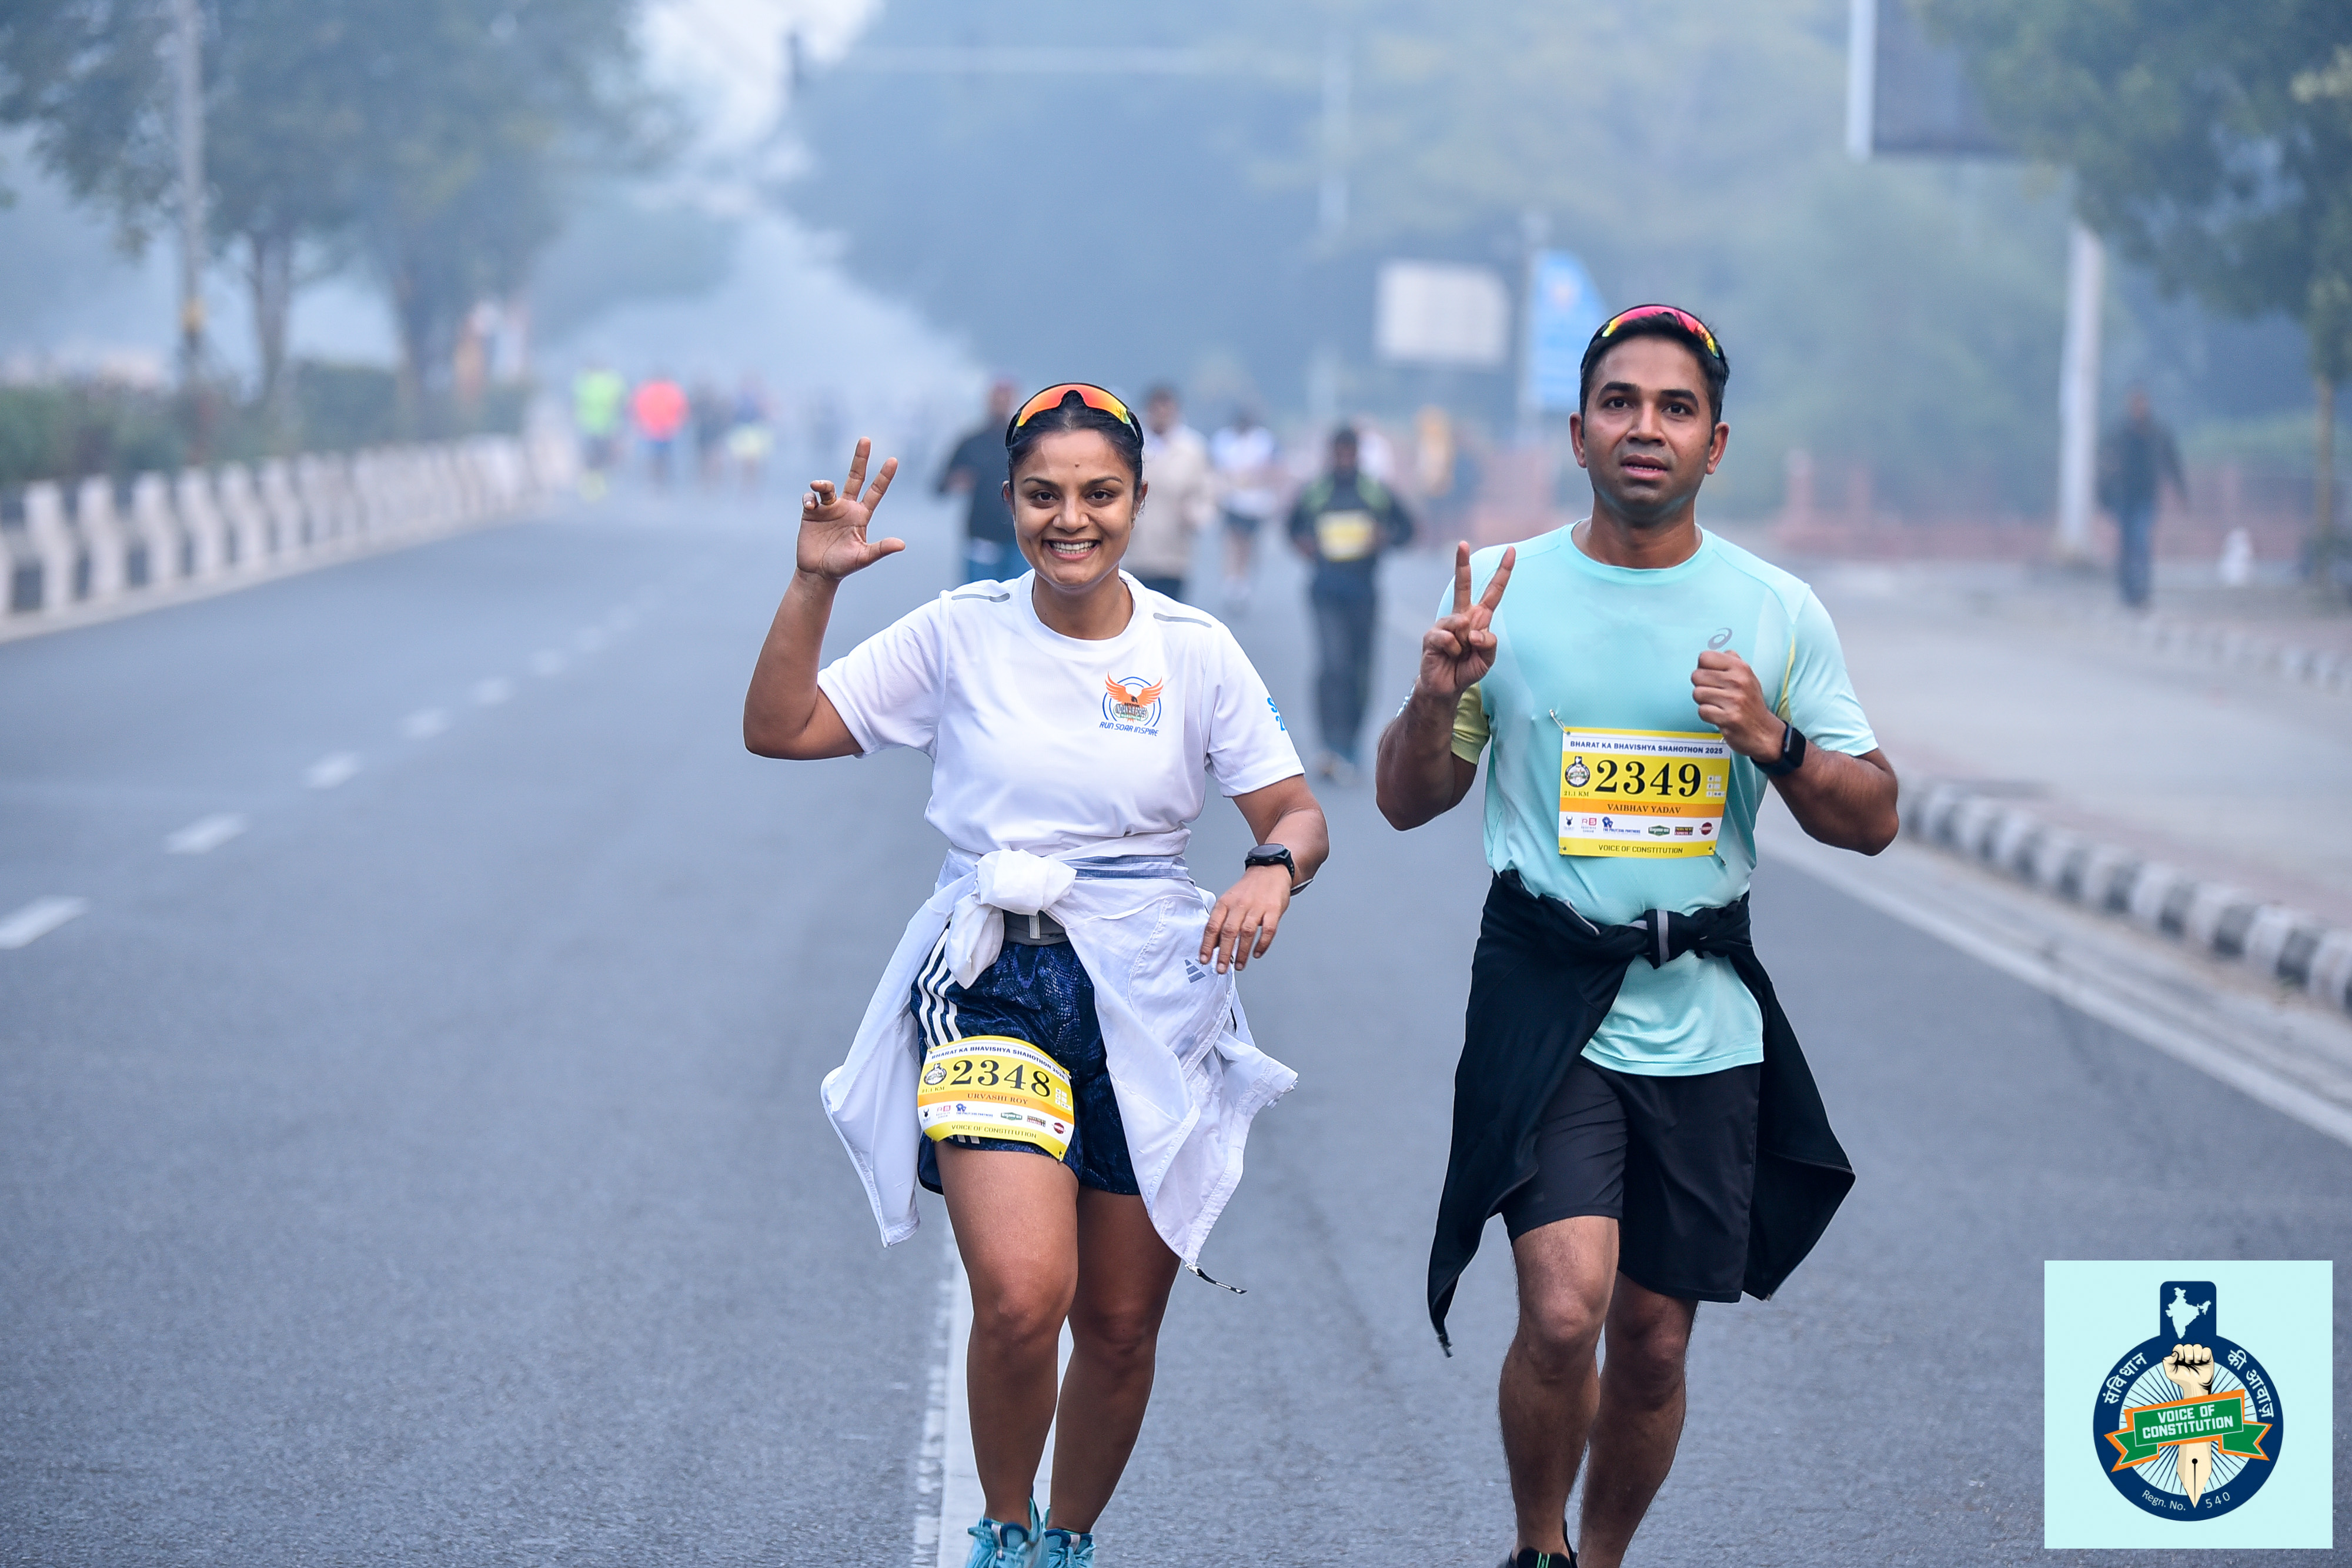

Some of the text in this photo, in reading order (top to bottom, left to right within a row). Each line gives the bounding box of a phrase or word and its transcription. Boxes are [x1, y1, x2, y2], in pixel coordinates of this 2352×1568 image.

[1114, 723, 1134, 733] SOAR
[1134, 726, 1159, 736] INSPIRE
[1614, 743, 1656, 751] BHAVISHYA
[1658, 745, 1703, 753] SHAHOTHON
[1594, 759, 1701, 797] 2349
[1607, 803, 1681, 814] VAIBHAV YADAV
[931, 1049, 957, 1059] BHARAT
[1013, 1049, 1051, 1069] SHAHOTHON
[950, 1060, 1050, 1097] 2348
[967, 1093, 1007, 1101] URVASHI
[984, 1126, 1037, 1138] CONSTITUTION
